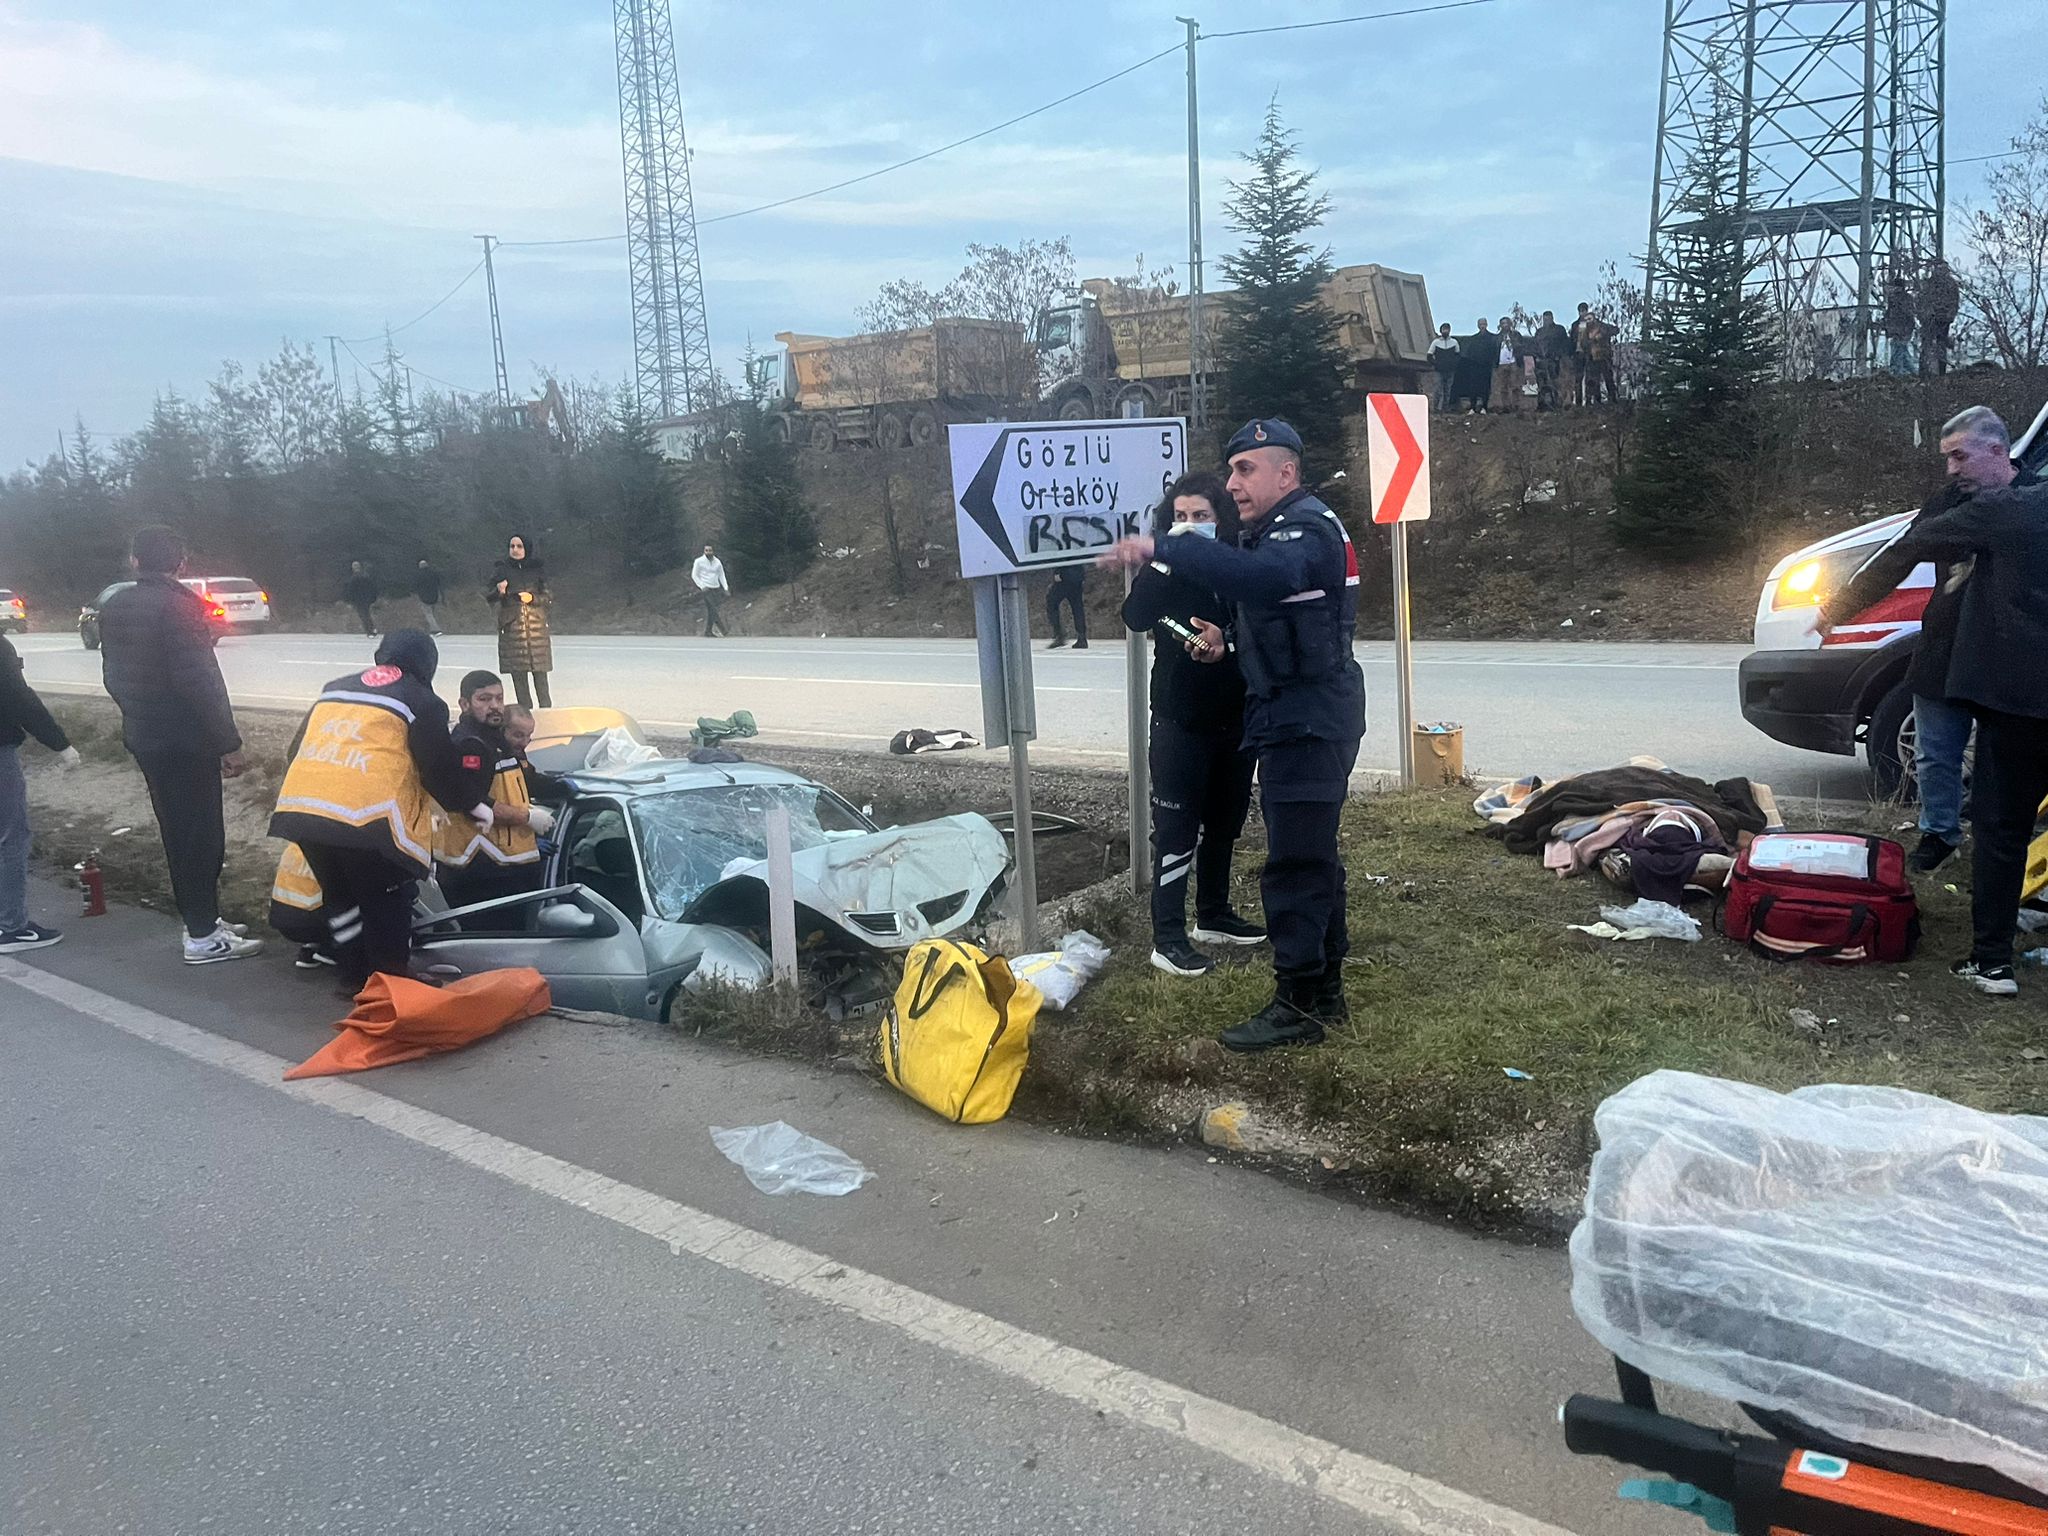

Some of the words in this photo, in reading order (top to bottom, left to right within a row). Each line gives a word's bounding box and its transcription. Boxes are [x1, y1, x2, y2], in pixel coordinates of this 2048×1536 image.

[1017, 435, 1111, 469] Gözlü
[1161, 431, 1174, 460] 5
[1020, 476, 1119, 511] Ortaköy
[1162, 470, 1175, 496] 6
